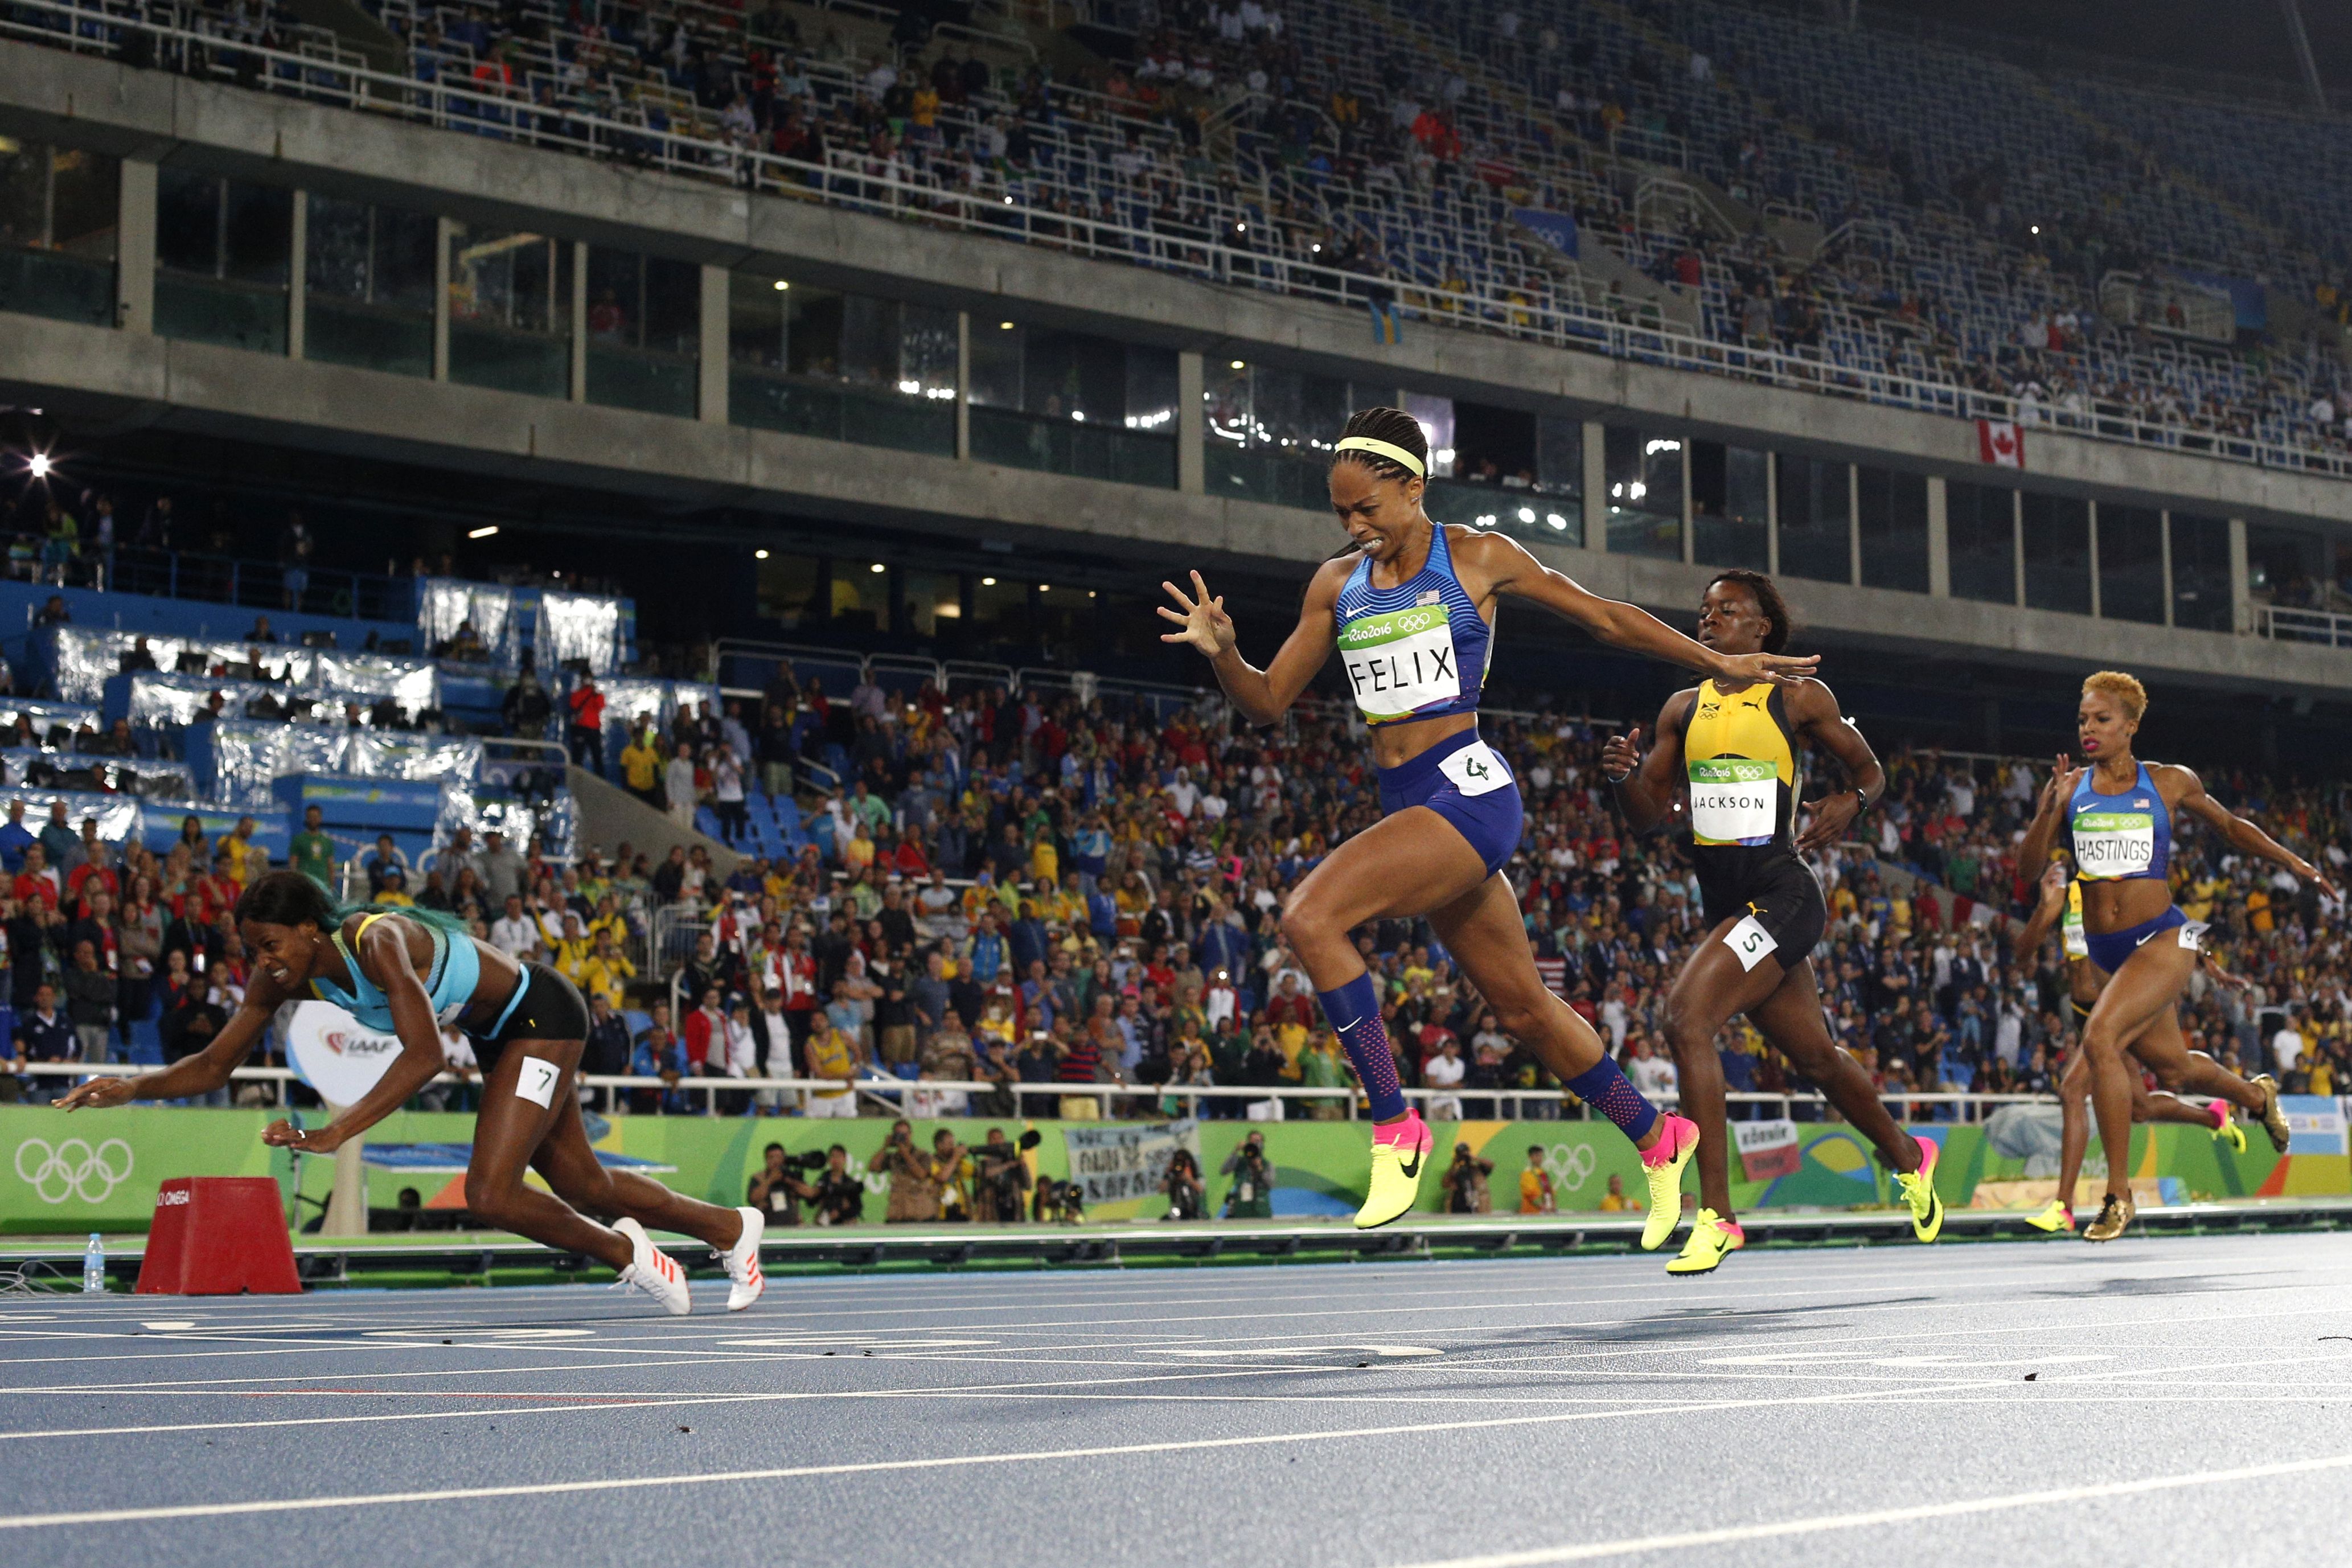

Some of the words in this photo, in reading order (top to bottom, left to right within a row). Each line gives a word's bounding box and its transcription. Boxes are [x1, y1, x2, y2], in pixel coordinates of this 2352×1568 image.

[1348, 622, 1393, 642] Rio2016
[1349, 646, 1455, 695] FELIX
[1467, 757, 1489, 781] 4
[1698, 766, 1731, 778] Rio2016
[1694, 797, 1764, 810] JACKSON
[2077, 840, 2150, 861] HASTINGS
[1743, 931, 1763, 953] 5
[348, 1039, 394, 1053] IAAF
[538, 1068, 551, 1091] 7
